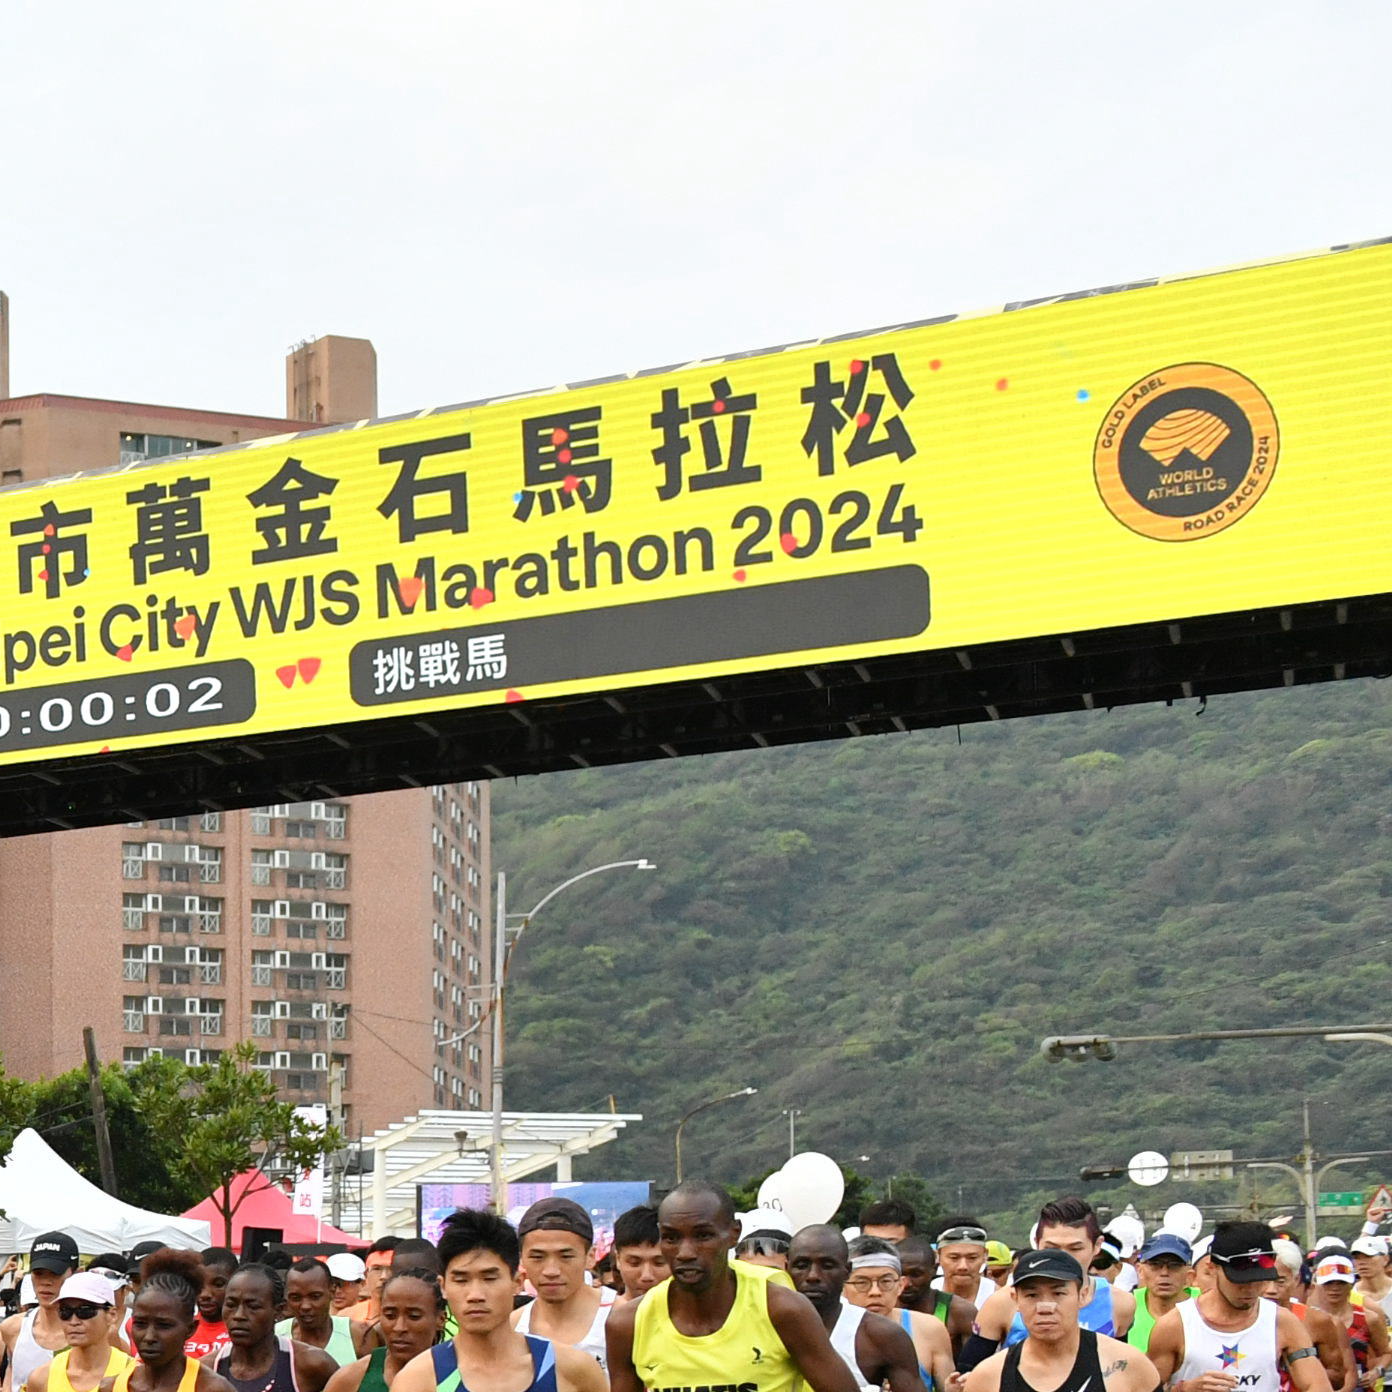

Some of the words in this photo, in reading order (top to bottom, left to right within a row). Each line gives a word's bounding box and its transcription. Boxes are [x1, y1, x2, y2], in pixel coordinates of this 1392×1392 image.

[1102, 410, 1125, 448] GOLD
[1123, 377, 1166, 409] LABEL
[1147, 478, 1227, 500] ATHLETICS
[1160, 467, 1213, 485] WORLD
[1183, 509, 1225, 531] ROAD
[1226, 478, 1258, 513] RACE
[1254, 436, 1270, 475] 2024
[99, 591, 220, 658] City
[229, 568, 360, 639] WJS
[376, 525, 715, 620] Marathon
[731, 483, 923, 568] 2024
[373, 634, 508, 695] 挑戰馬
